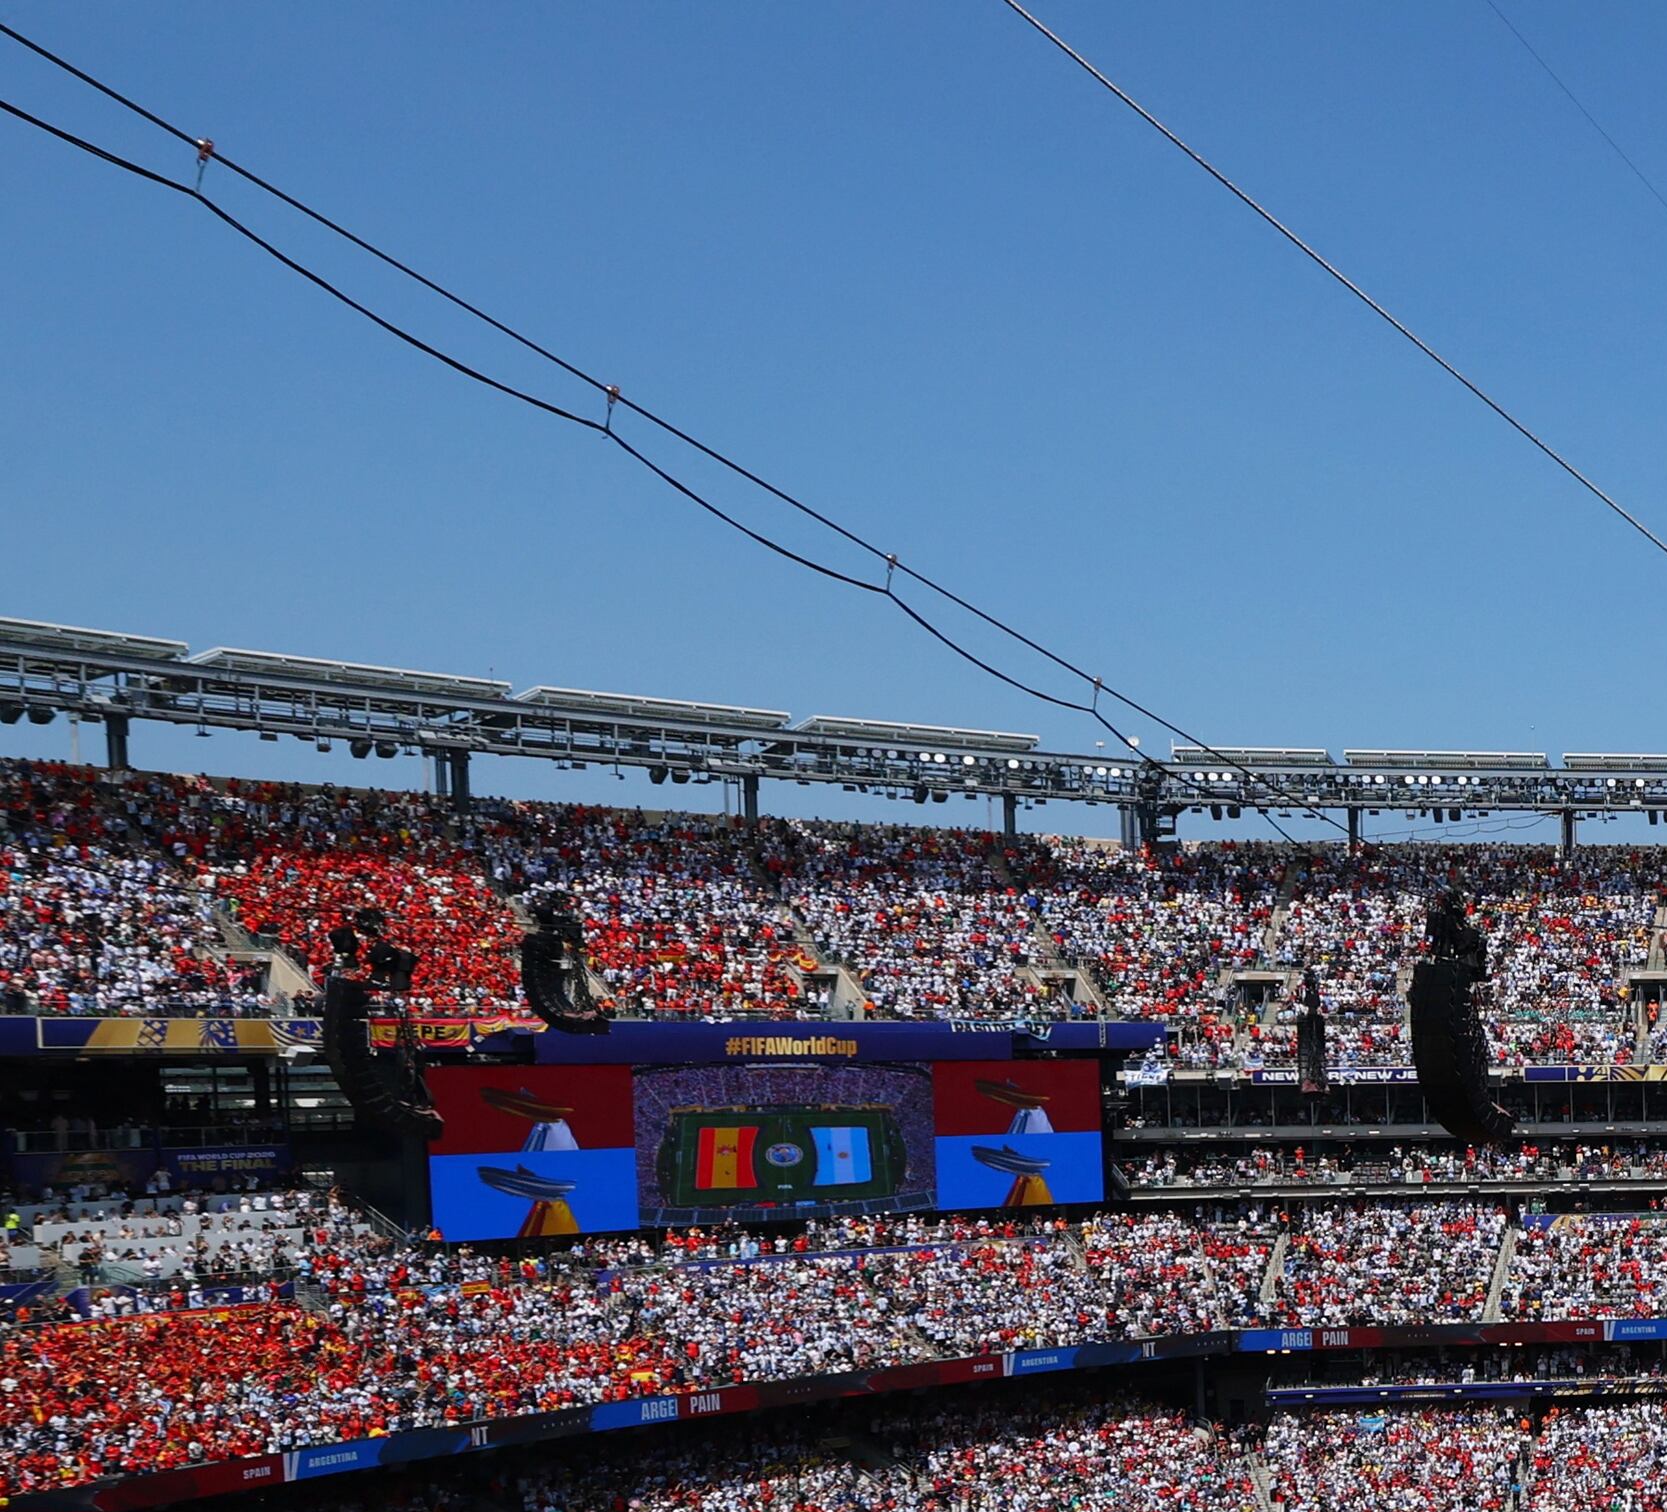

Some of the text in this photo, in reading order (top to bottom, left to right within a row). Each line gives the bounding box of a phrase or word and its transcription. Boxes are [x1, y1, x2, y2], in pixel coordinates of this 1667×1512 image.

[726, 1036, 857, 1058] #FIFAWorldCup
[1262, 1070, 1382, 1082] NEW NEW
[197, 1153, 228, 1161] WORLD
[180, 1158, 278, 1172] THE FINAL
[1576, 1327, 1596, 1335] SPAIN
[1621, 1325, 1656, 1334] ARGENTINA
[973, 1363, 994, 1373] SPAIN
[1021, 1355, 1058, 1368] ARGENTINA
[243, 1466, 271, 1480] SPAIN
[308, 1451, 358, 1467] ARGENTINA
